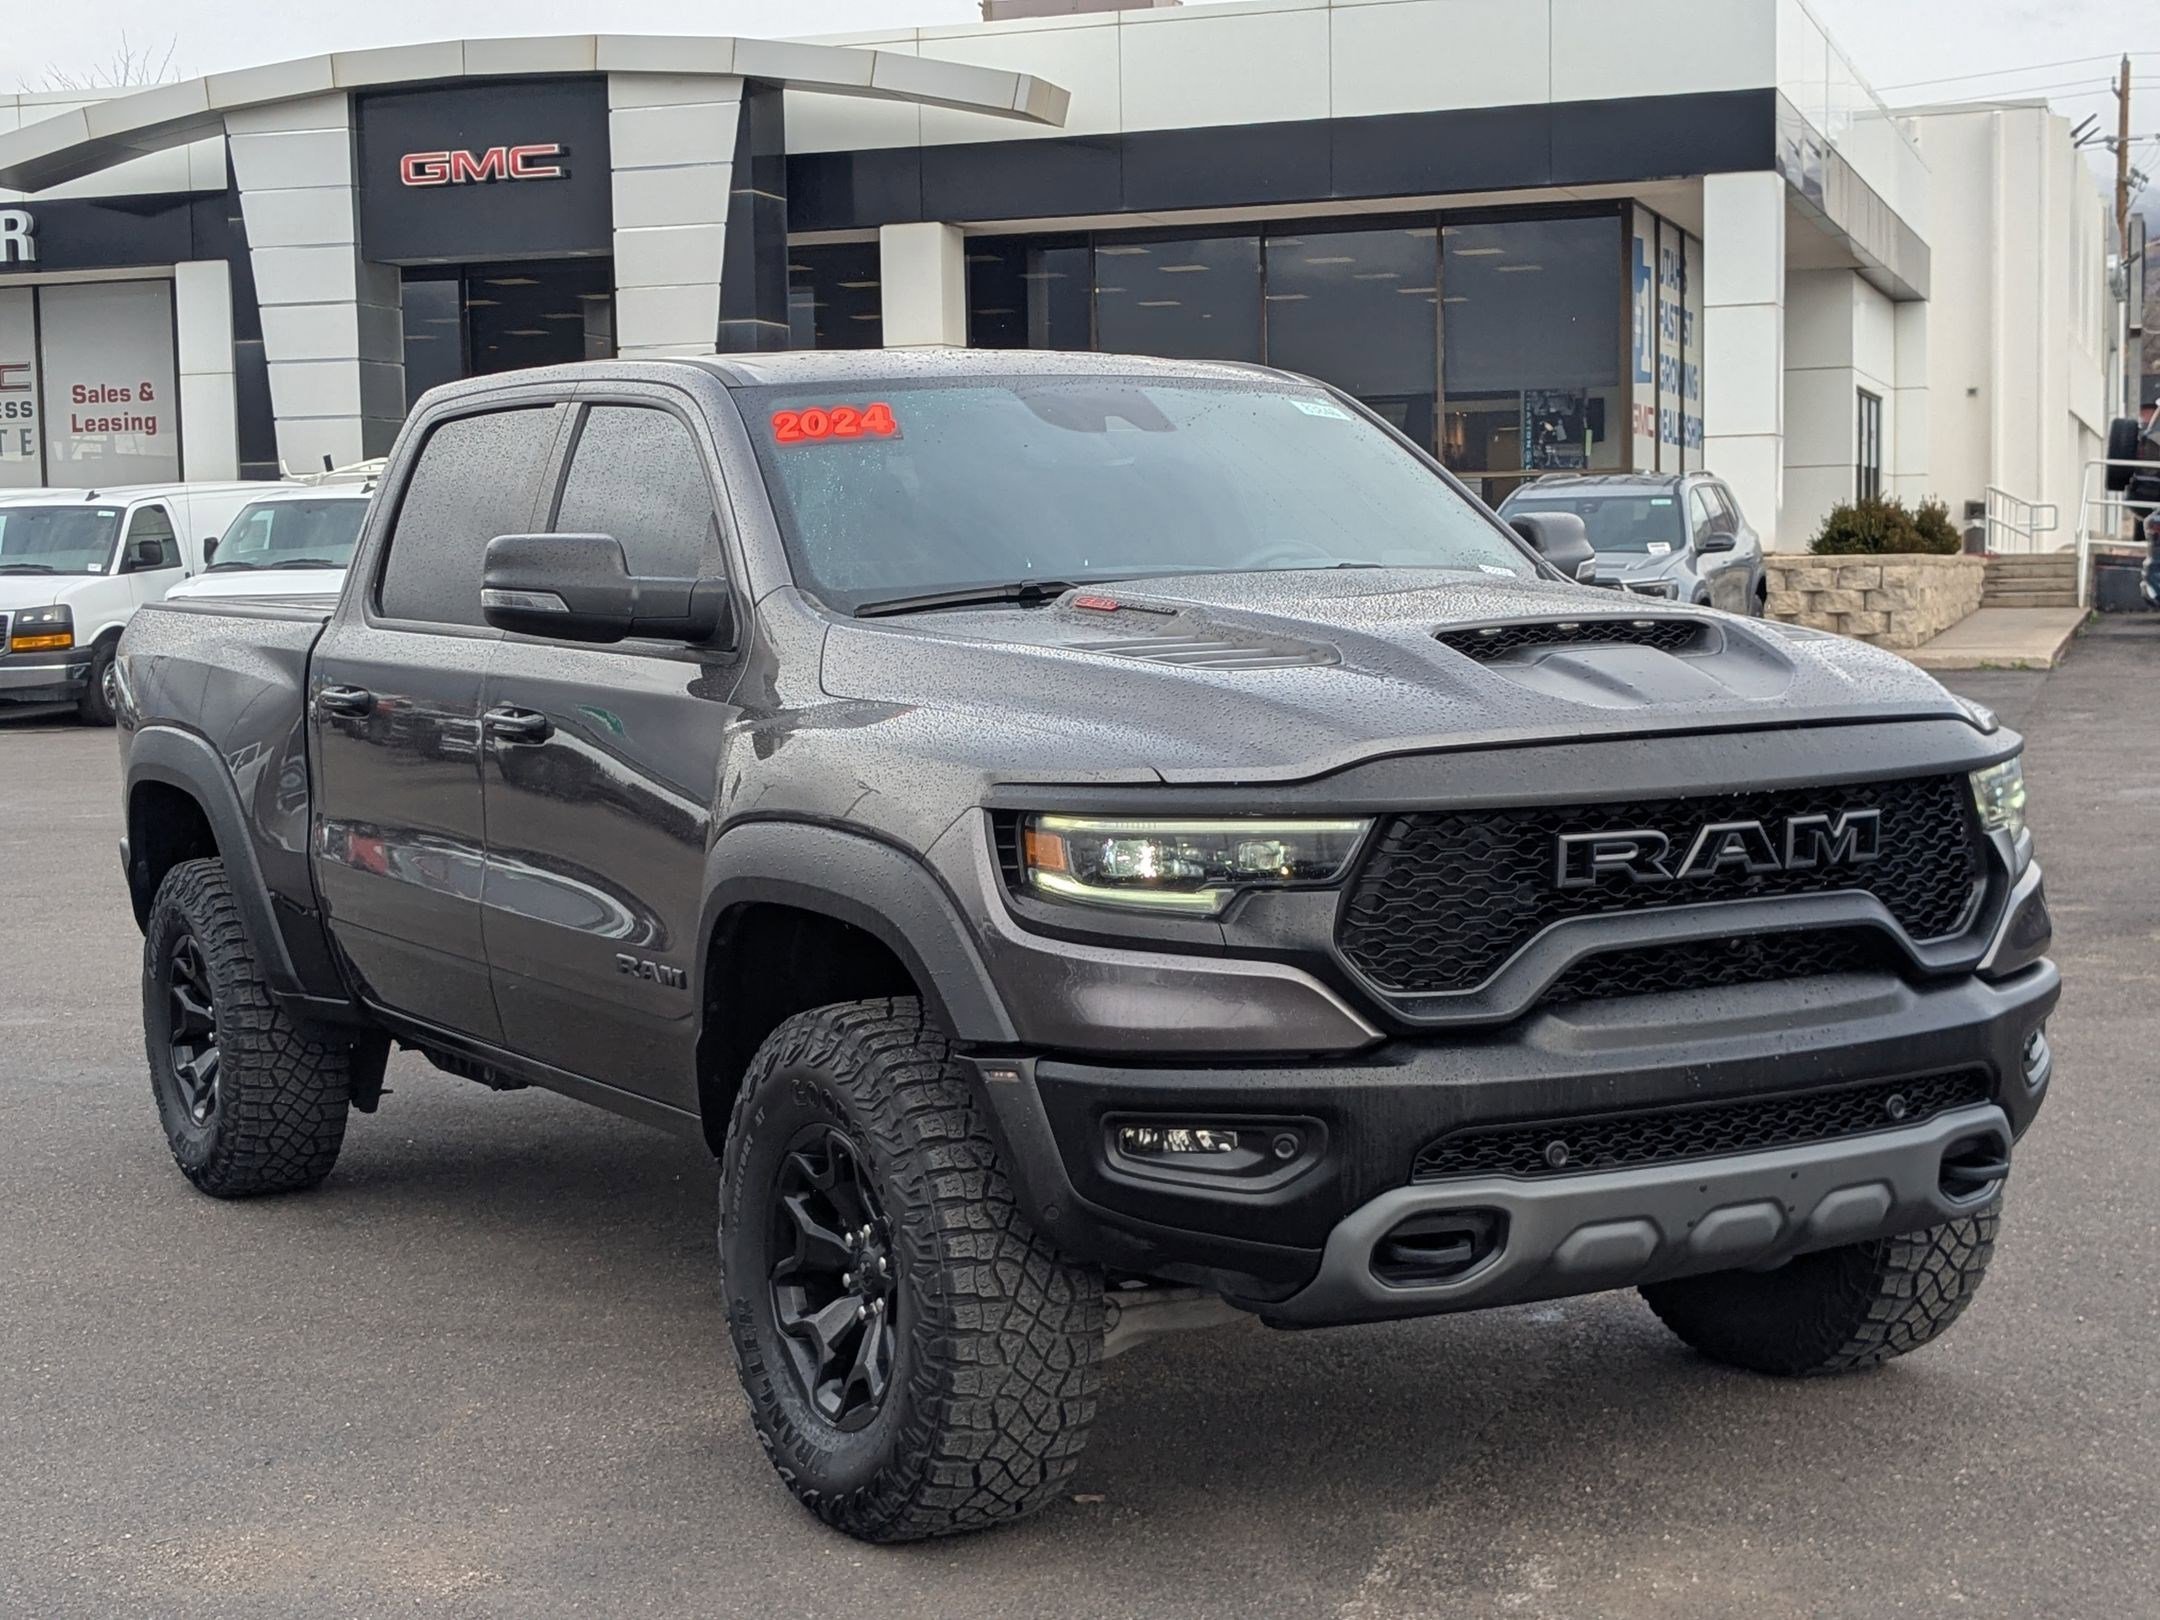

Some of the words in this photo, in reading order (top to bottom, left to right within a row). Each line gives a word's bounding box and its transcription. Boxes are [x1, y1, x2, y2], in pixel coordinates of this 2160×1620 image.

[400, 143, 563, 187] GMC
[1660, 299, 1693, 347] FASTST
[72, 384, 131, 404] Sales
[139, 382, 154, 401] &
[1660, 353, 1698, 401] GROING
[0, 401, 33, 419] SS
[71, 412, 157, 436] Leasing
[772, 403, 897, 442] 2024
[1660, 408, 1703, 450] EALSHIP
[1557, 809, 1881, 889] RAM
[615, 953, 687, 990] RAM
